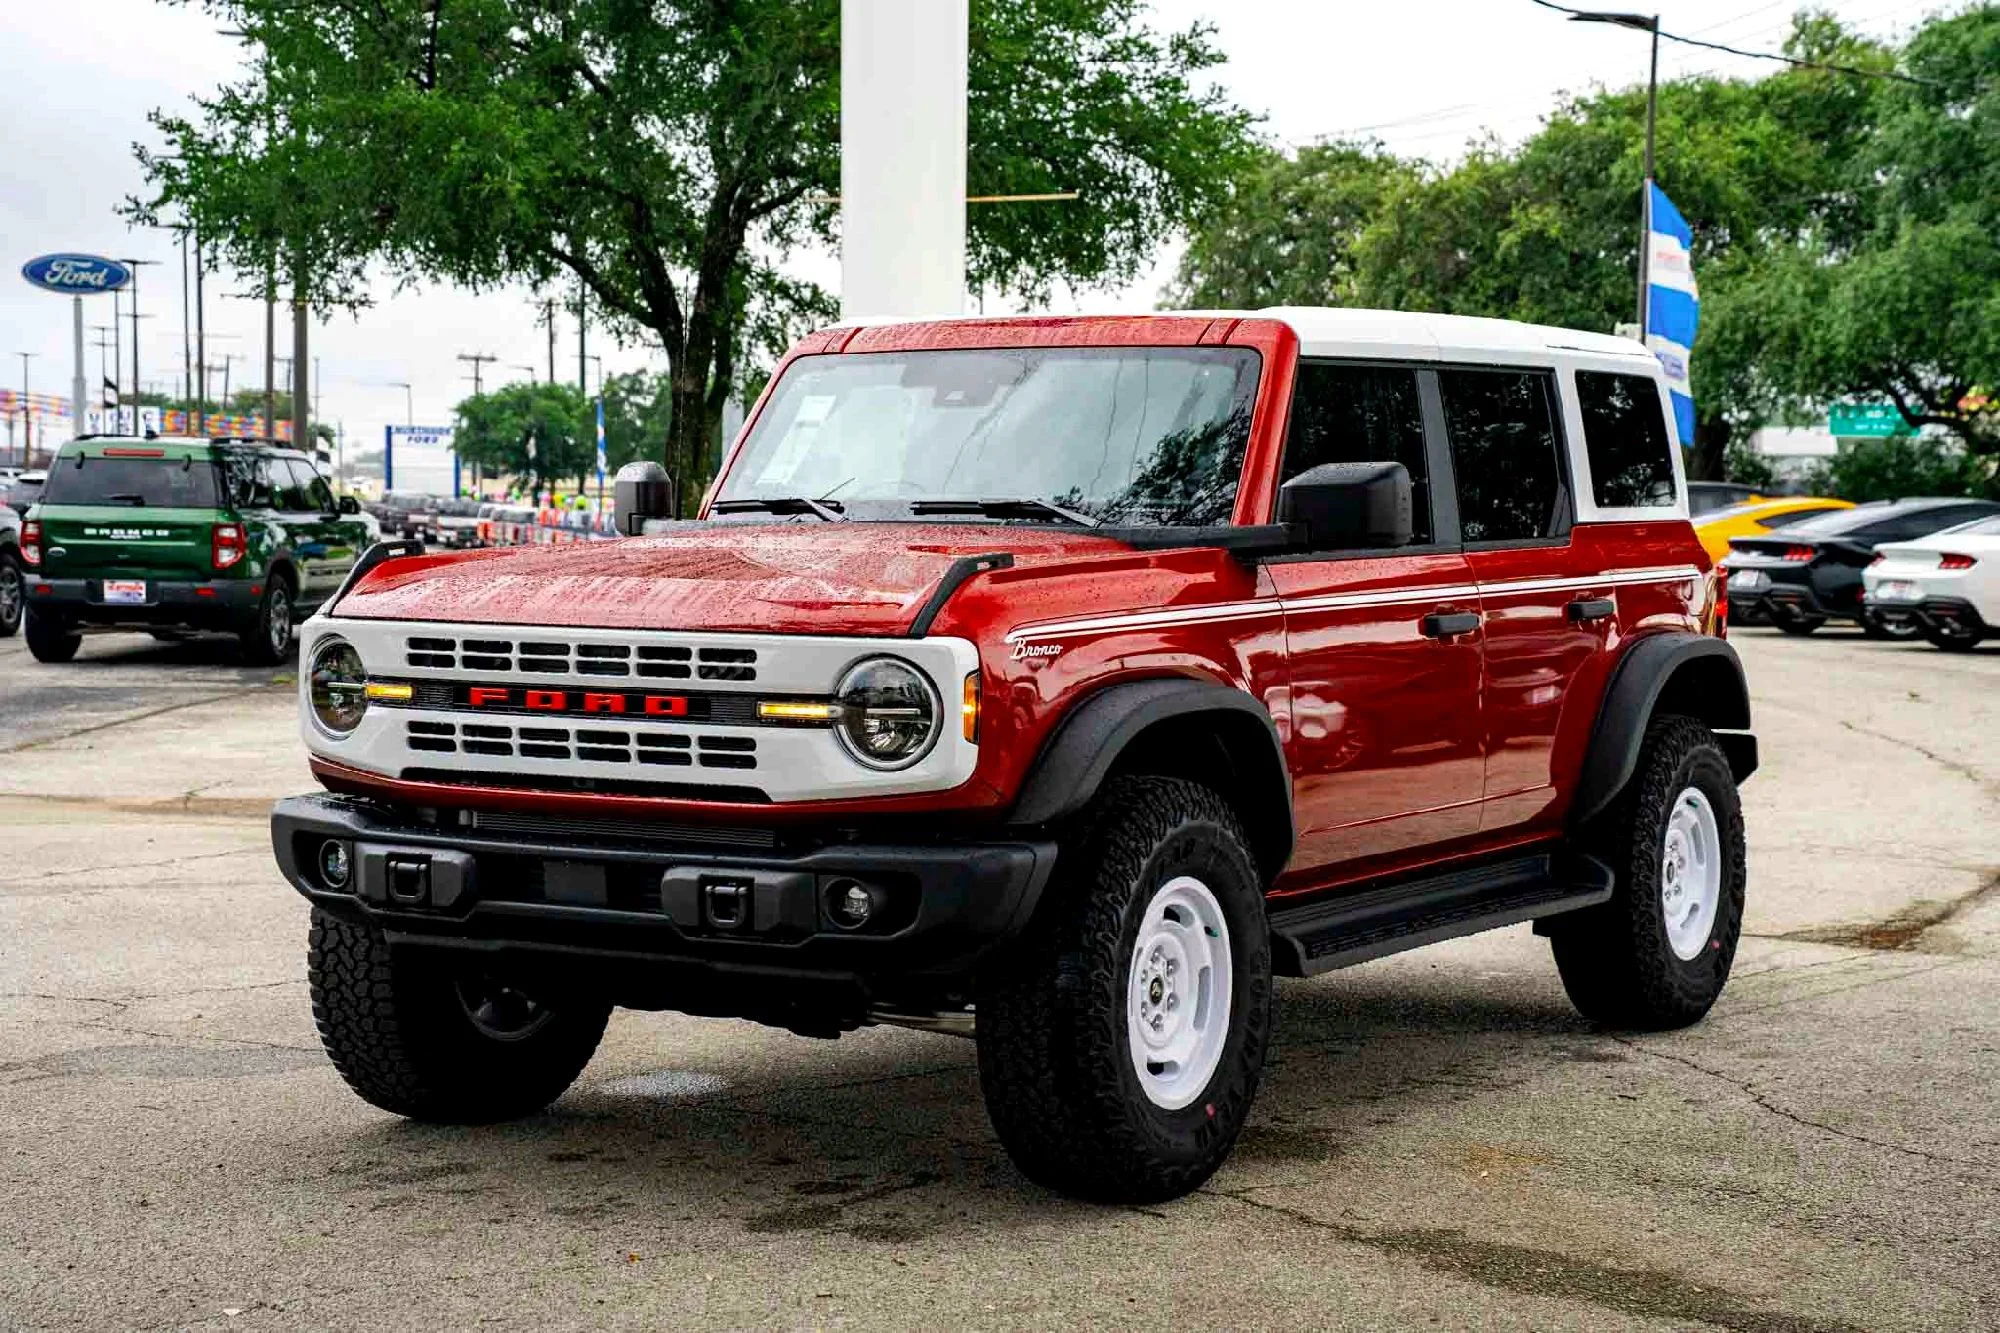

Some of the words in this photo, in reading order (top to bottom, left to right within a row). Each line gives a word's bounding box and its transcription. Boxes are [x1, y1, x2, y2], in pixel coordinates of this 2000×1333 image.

[44, 259, 109, 286] Ford
[83, 527, 170, 537] BRONCO
[1009, 637, 1064, 660] Bronco
[469, 686, 689, 717] FORD
